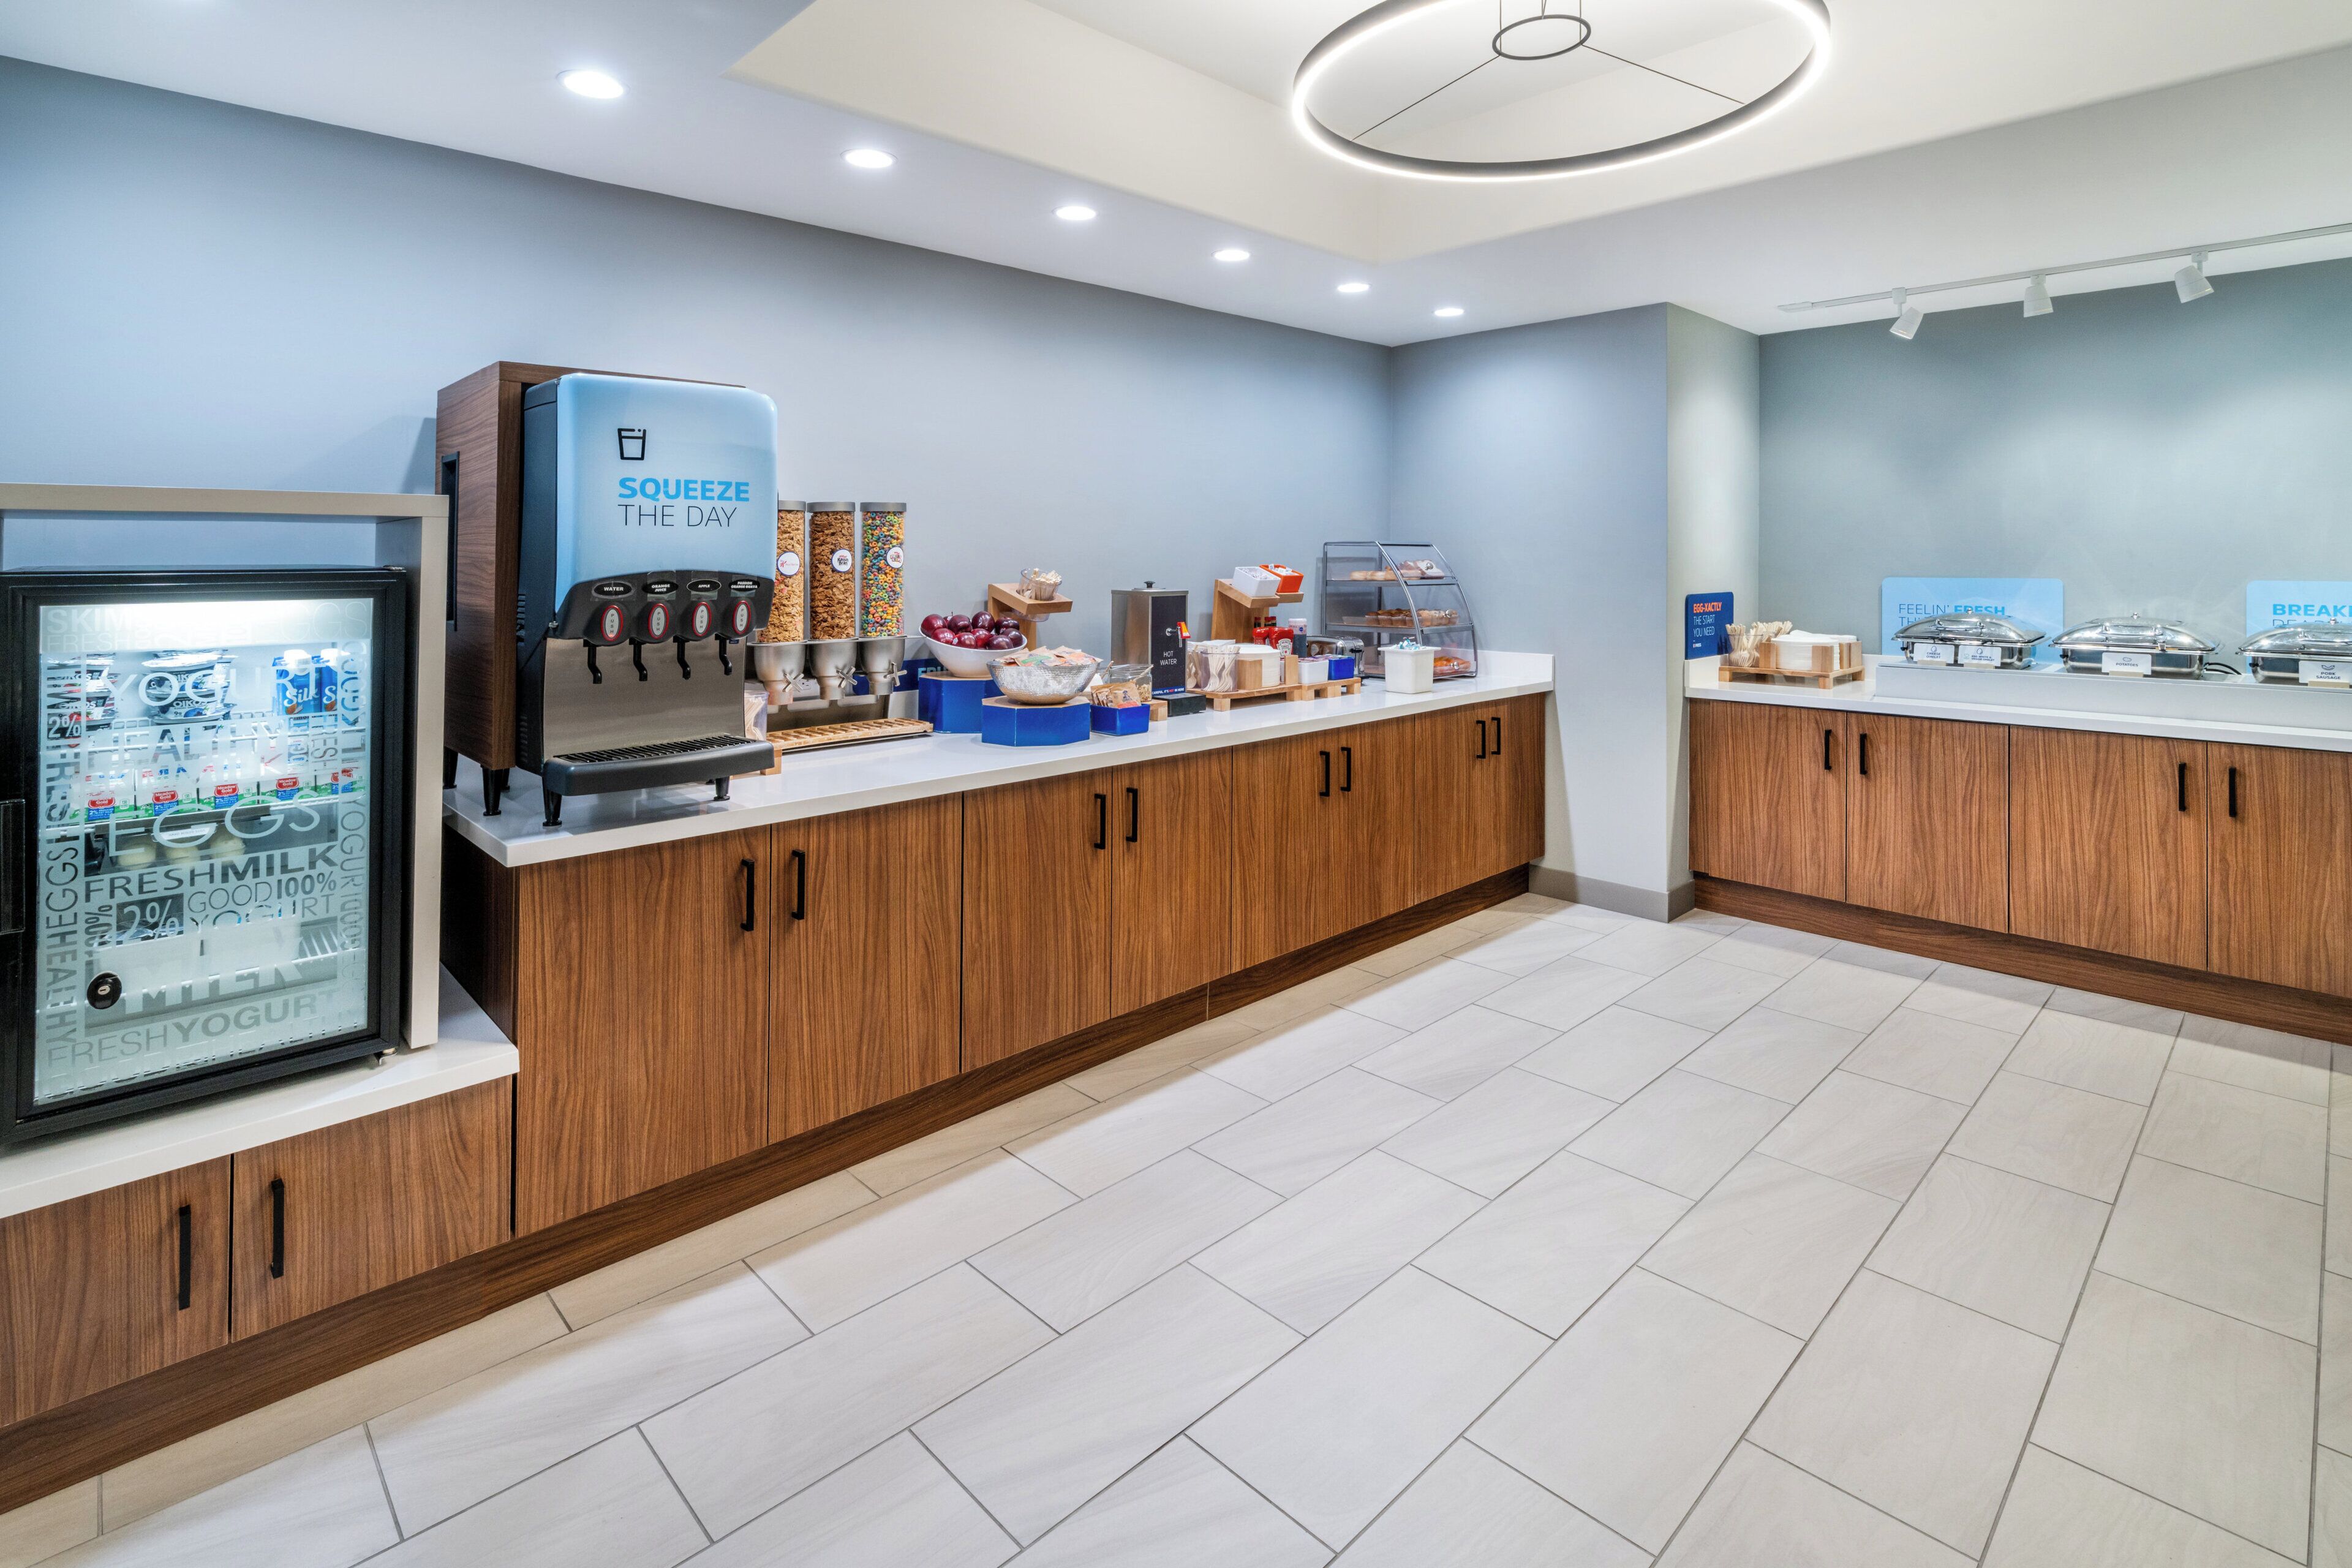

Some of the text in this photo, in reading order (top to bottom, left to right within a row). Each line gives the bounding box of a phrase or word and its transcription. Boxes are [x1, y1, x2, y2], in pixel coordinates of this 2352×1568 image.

[618, 477, 749, 502] SQUEEZE
[617, 504, 737, 527] THE DAY
[1693, 602, 1722, 613] EGG-XACTLY
[1703, 614, 1715, 625] START
[1899, 603, 1949, 615] FEELIN'
[47, 608, 132, 633] SKIM
[1693, 626, 1714, 637] YOU NEED
[47, 633, 128, 653] FRESH
[99, 663, 327, 709] YOGURT
[48, 715, 81, 739] 2%
[109, 788, 320, 856] EGGS
[341, 794, 366, 899] YOGURT
[45, 846, 78, 929] EGGS
[187, 870, 337, 913] GOOD 100%
[123, 899, 180, 945] 2%
[46, 930, 78, 1043] HEALTHY
